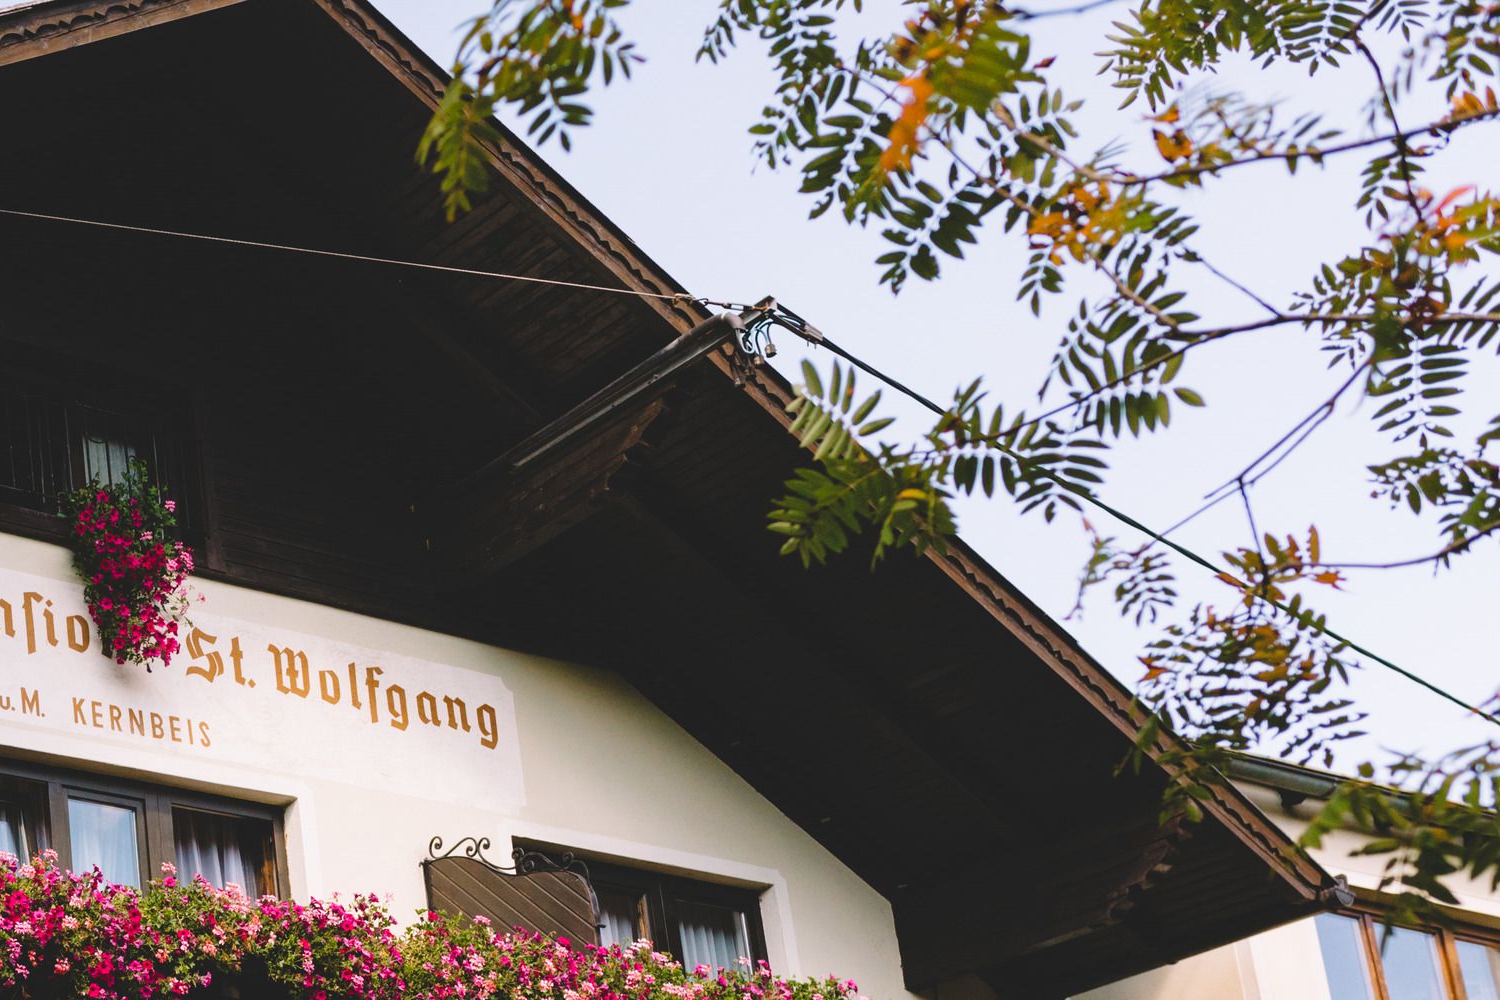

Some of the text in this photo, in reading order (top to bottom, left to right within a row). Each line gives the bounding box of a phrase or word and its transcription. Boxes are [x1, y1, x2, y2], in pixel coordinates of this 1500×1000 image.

[72, 696, 211, 748] KERNBEIS
[185, 626, 256, 688] St.
[267, 643, 498, 750] Wolfgang
